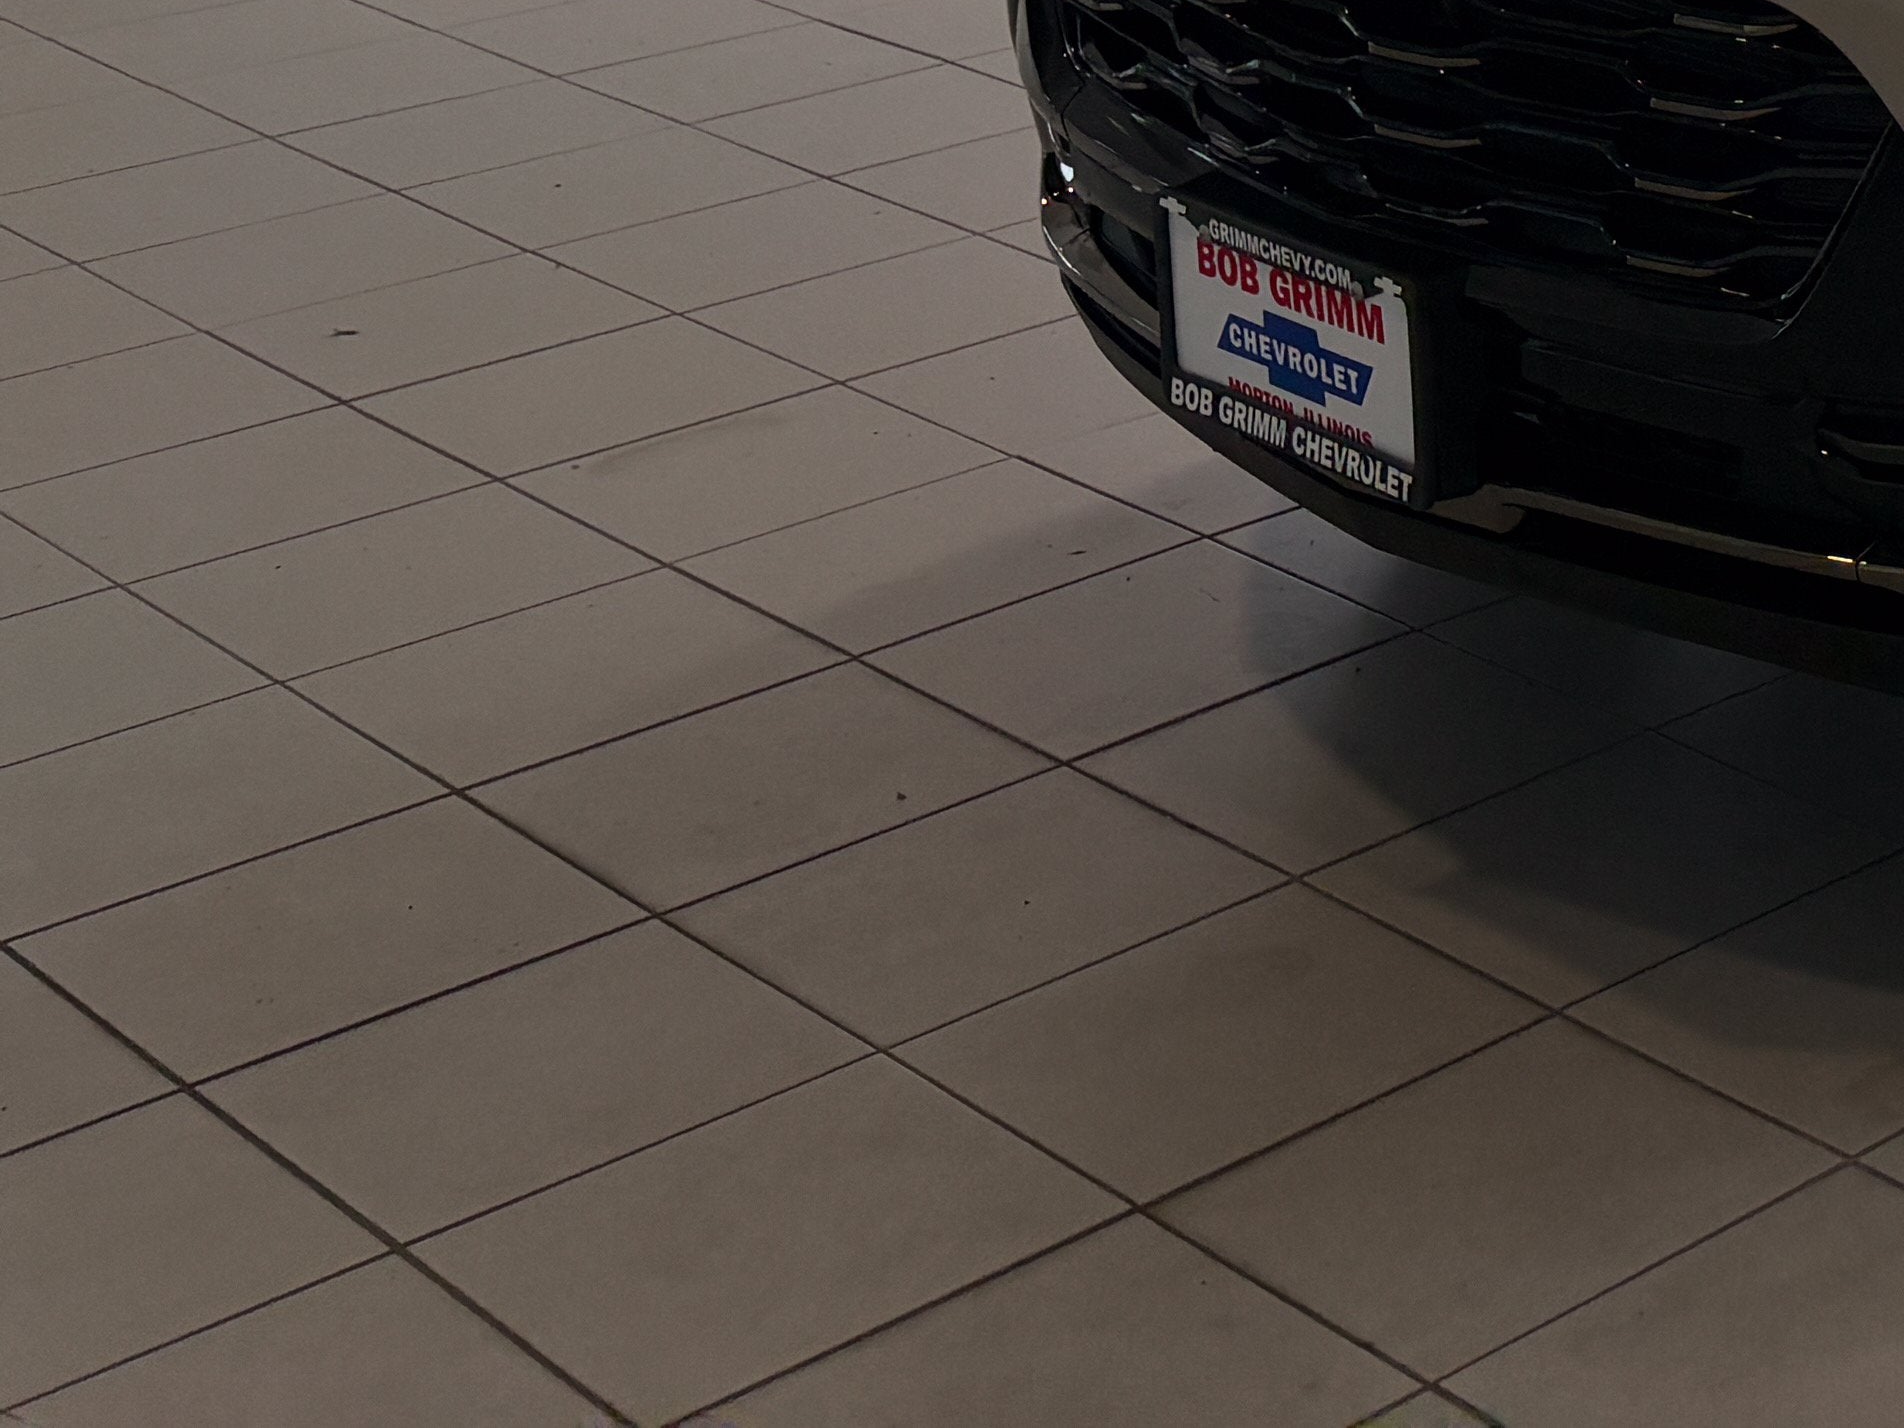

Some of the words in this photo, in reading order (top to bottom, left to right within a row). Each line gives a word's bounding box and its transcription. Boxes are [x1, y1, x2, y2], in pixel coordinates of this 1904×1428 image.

[1197, 235, 1261, 296] BOB
[1269, 268, 1386, 346] GRIMM
[1208, 218, 1352, 291] GRIMMCHEVY.COM
[1228, 323, 1359, 395] CHEVROLET
[1170, 377, 1213, 417] BOB
[1218, 396, 1288, 449] GRIMM
[1292, 426, 1413, 503] CHEVROLET
